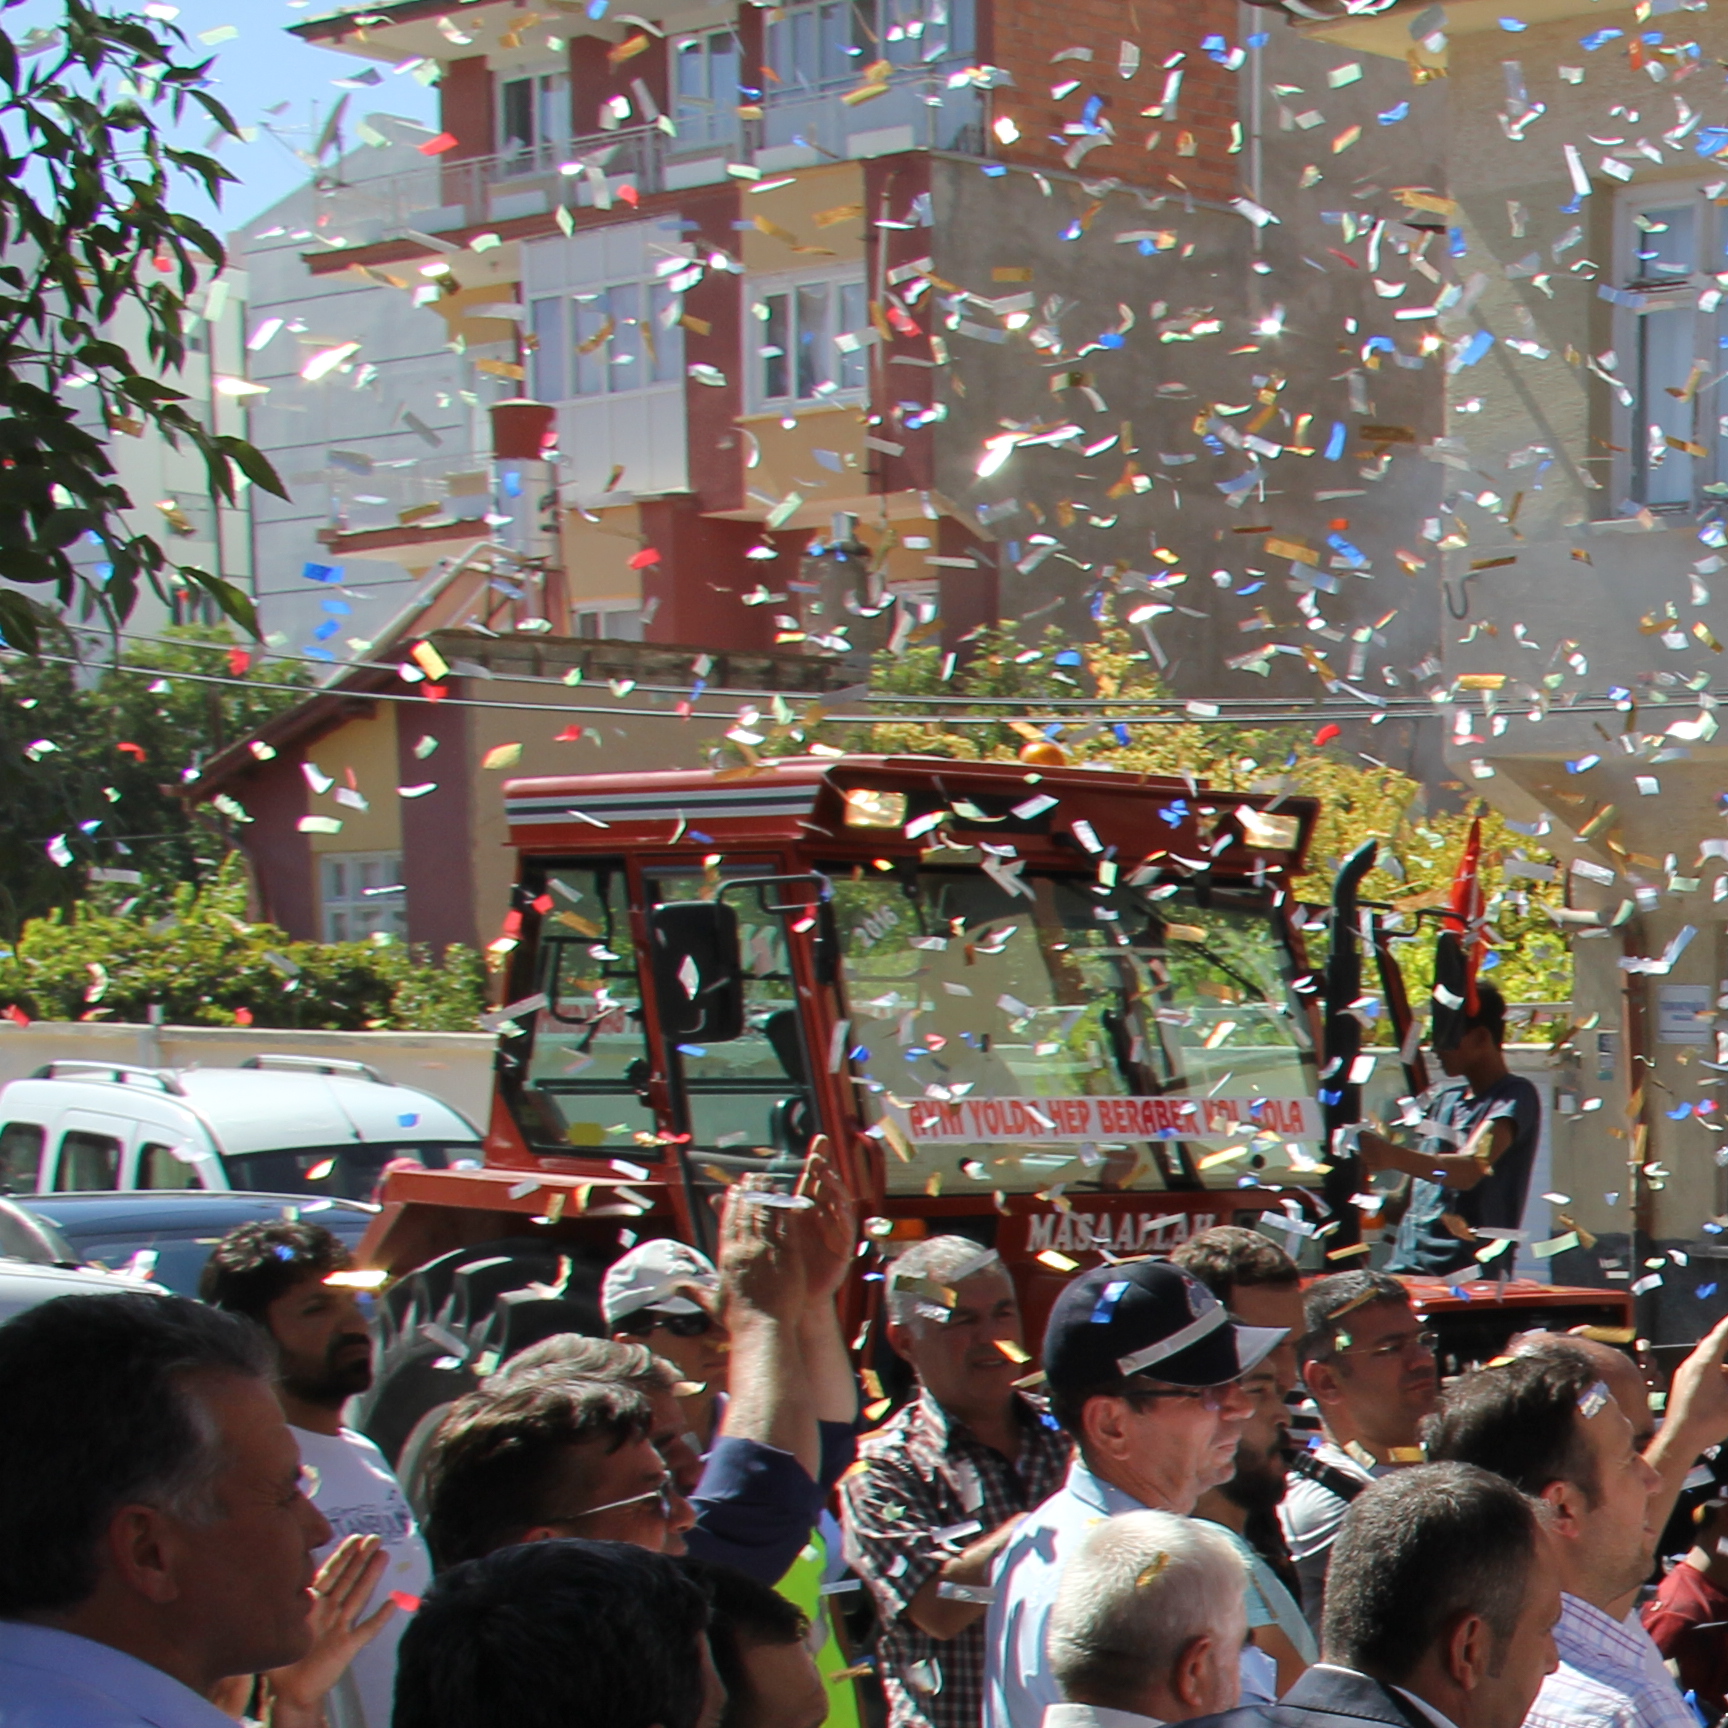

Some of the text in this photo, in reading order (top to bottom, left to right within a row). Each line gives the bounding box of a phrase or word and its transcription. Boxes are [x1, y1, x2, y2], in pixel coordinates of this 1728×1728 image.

[852, 905, 899, 948] 2016
[1046, 1100, 1090, 1137] HEP
[1097, 1100, 1199, 1135] BERABER
